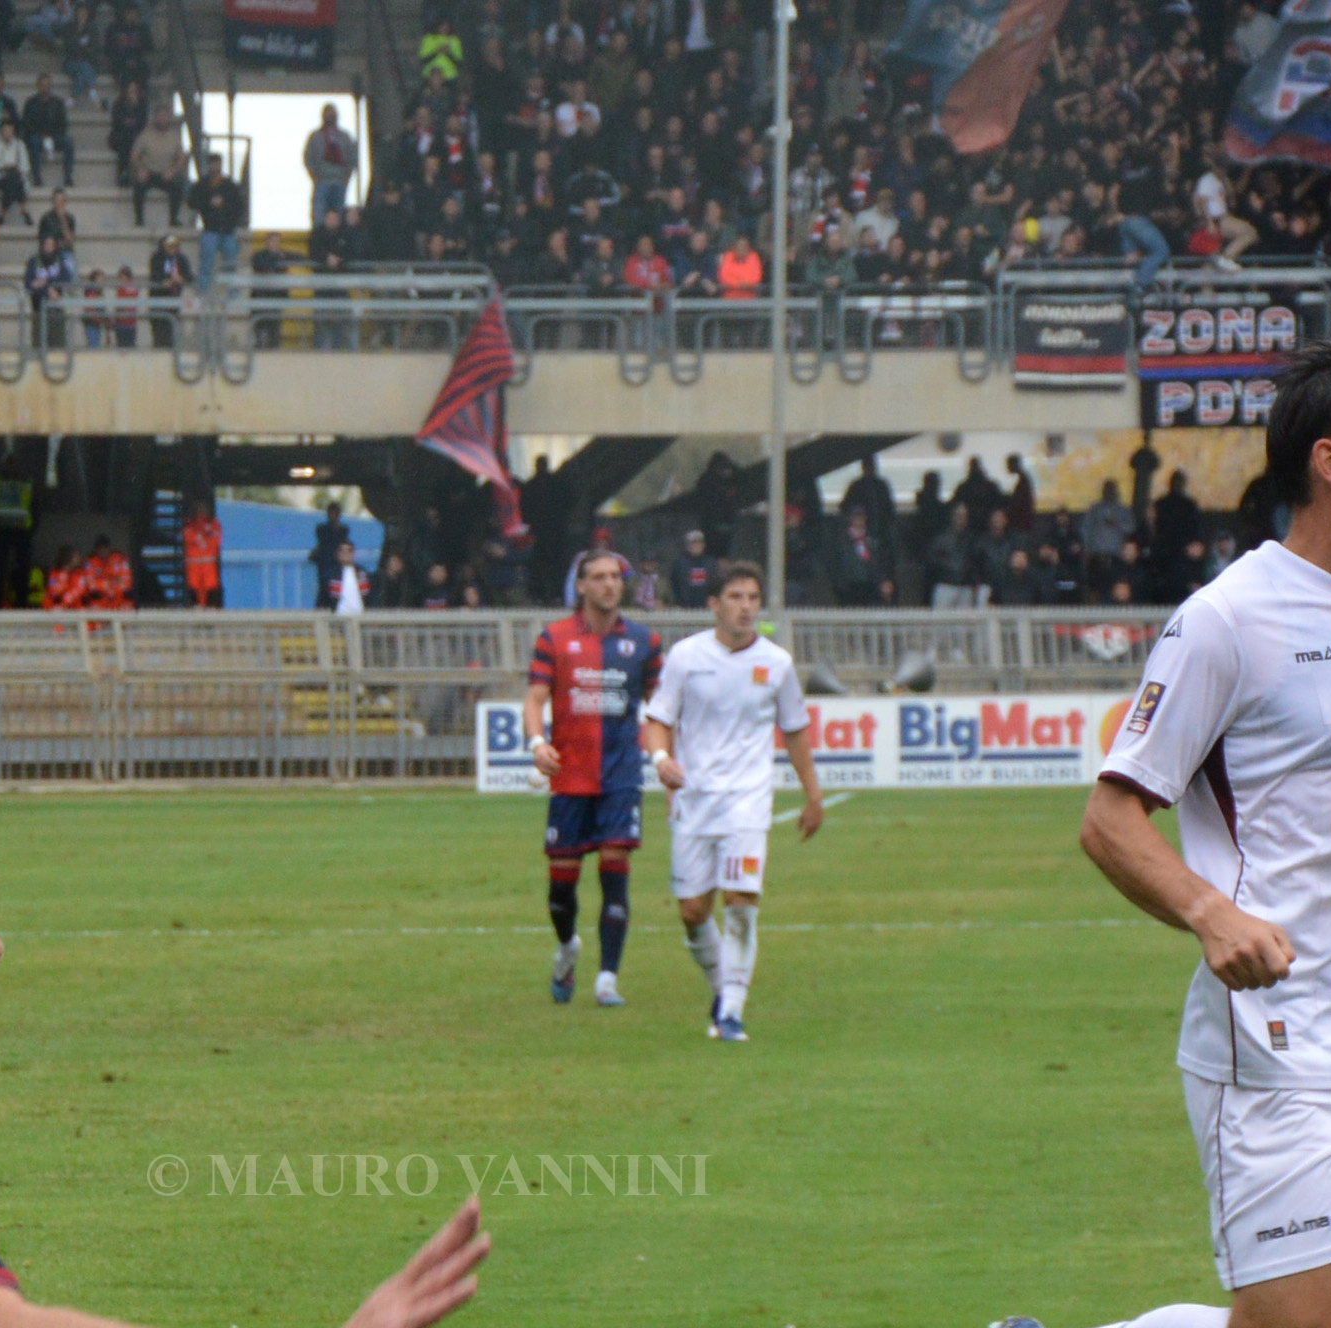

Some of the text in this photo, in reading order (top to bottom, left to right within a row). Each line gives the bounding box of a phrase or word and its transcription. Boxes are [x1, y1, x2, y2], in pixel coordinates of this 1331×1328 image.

[1141, 305, 1297, 356] ZONA
[899, 702, 1085, 761] BigMat
[899, 766, 1080, 781] HOME OF BUILDERS
